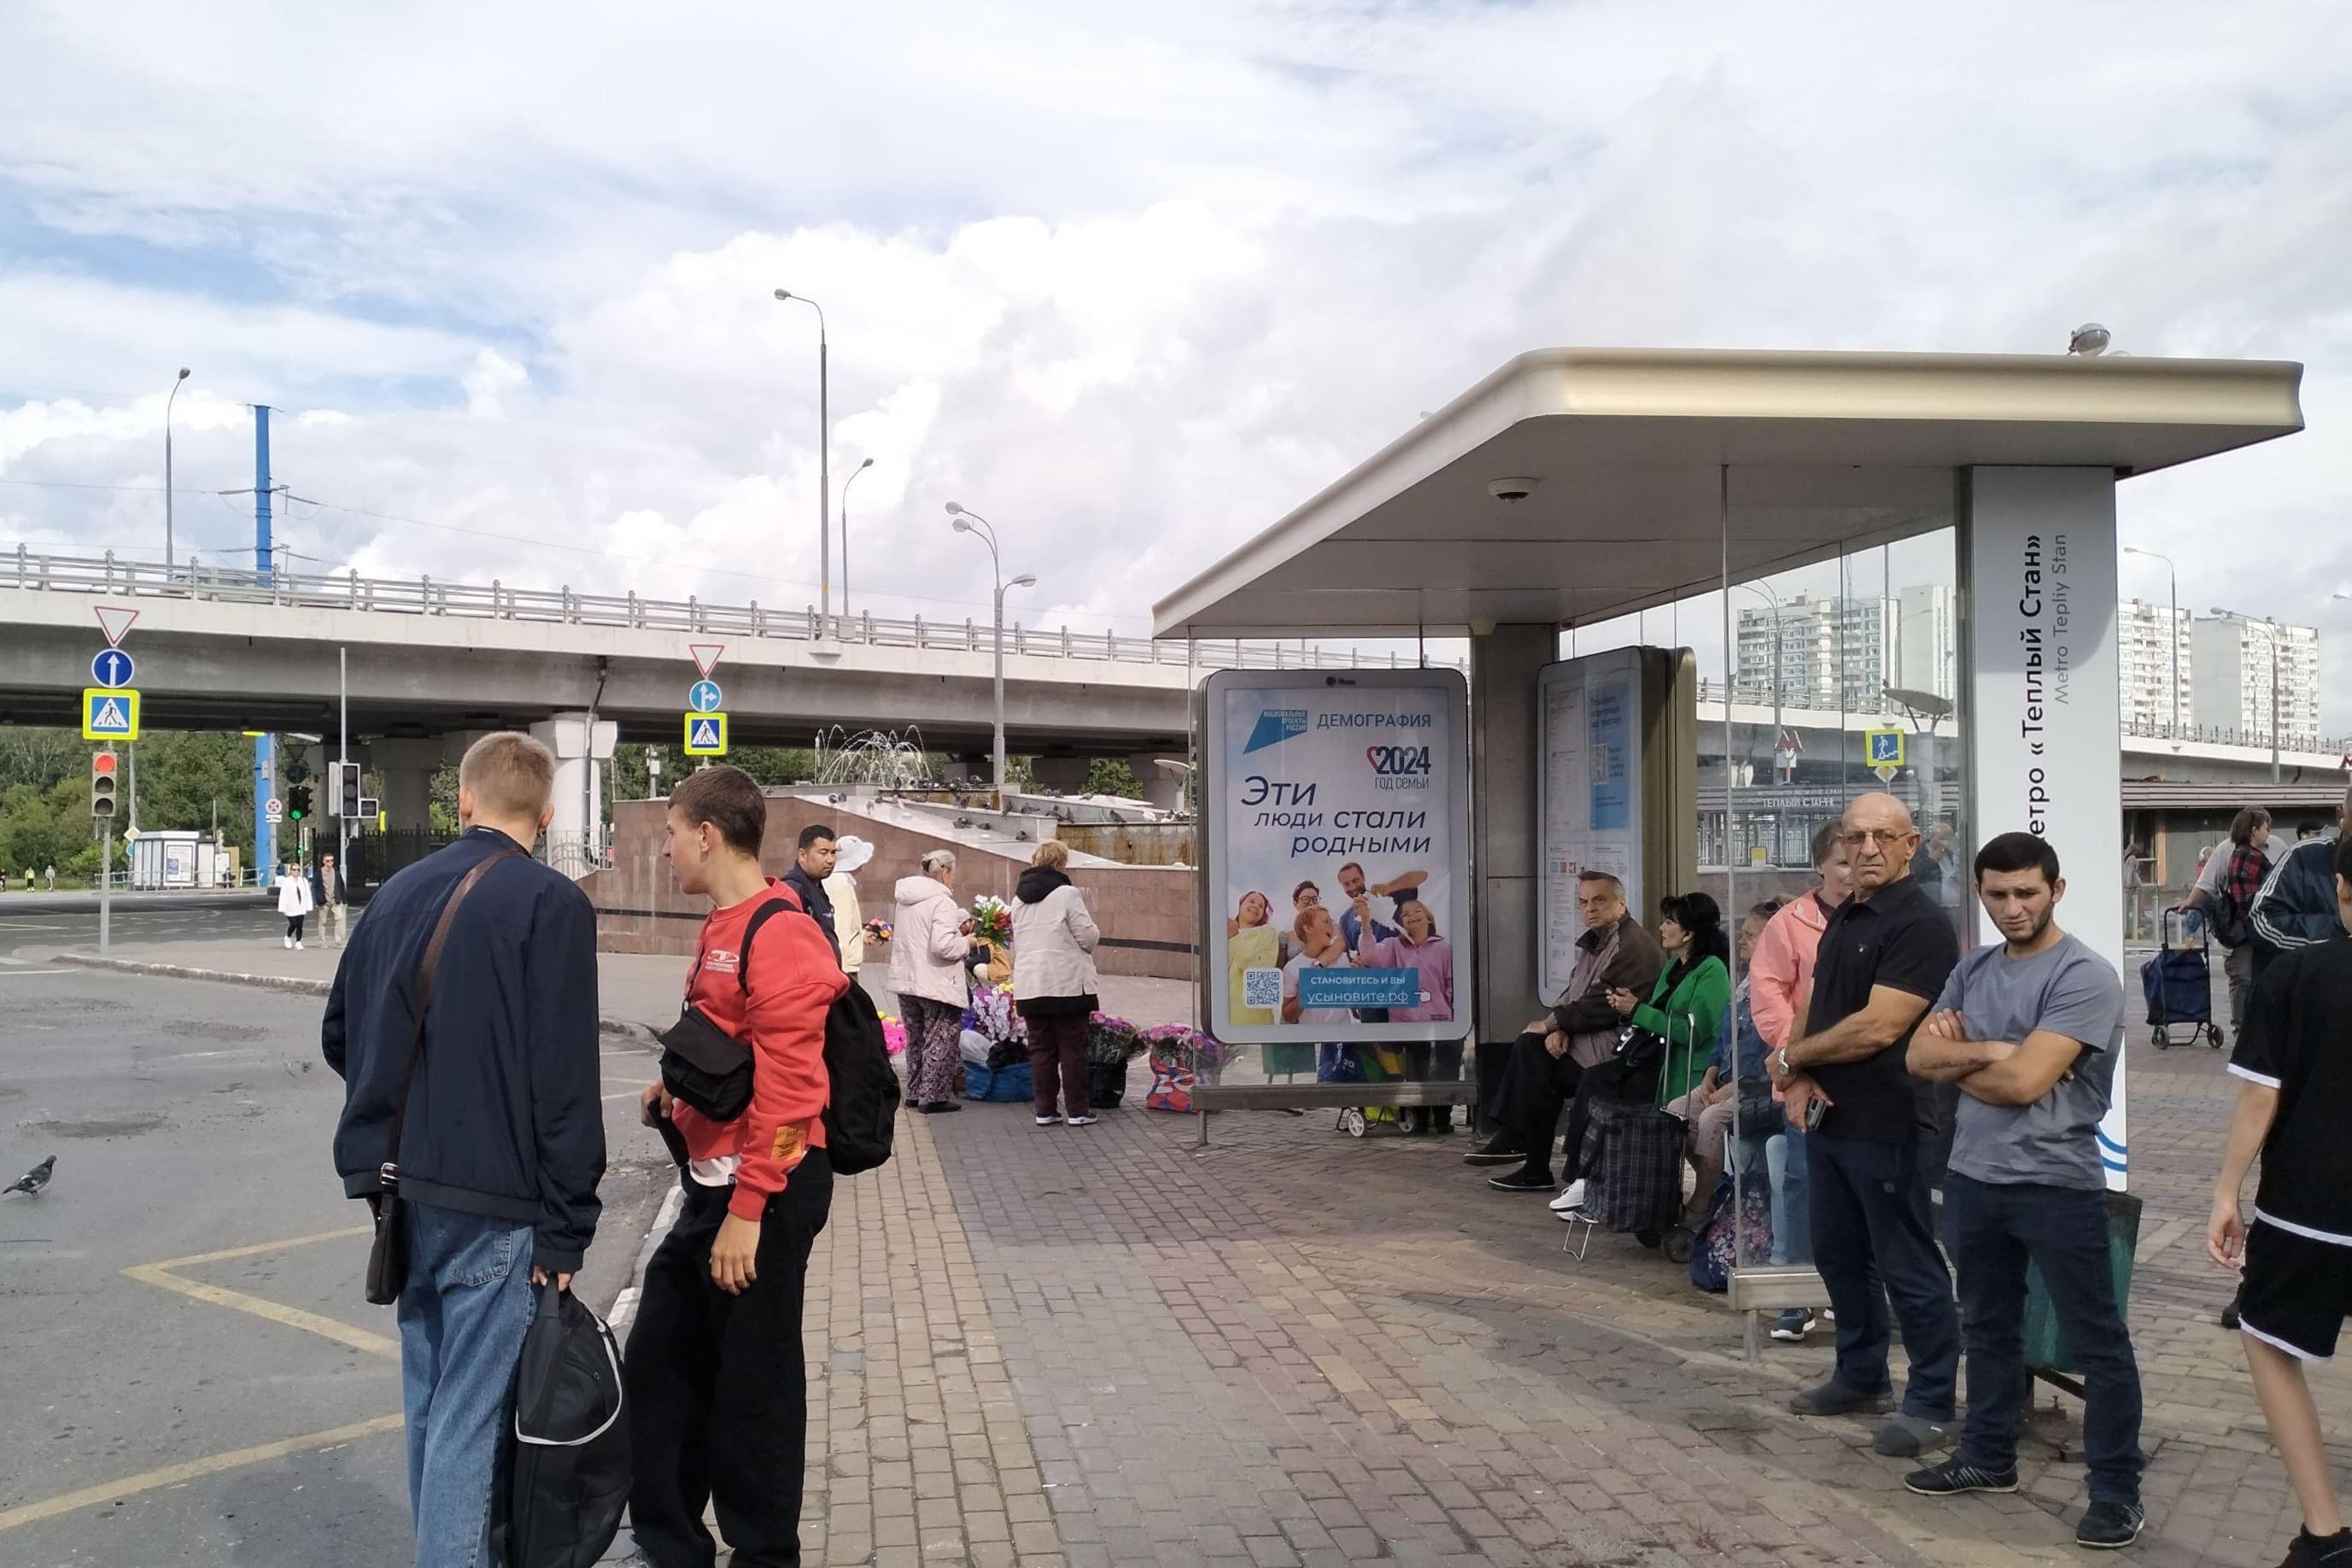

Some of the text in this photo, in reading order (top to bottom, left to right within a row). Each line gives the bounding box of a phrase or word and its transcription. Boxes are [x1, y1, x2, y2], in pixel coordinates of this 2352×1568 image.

[2052, 535, 2071, 705] Metro Tepliy Stan
[1316, 713, 1431, 729] ДЕМОГРАФИЯ
[1375, 746, 1431, 775] 2024
[1241, 775, 1316, 806] Эти
[1375, 777, 1394, 792] ГОД
[2027, 766, 2049, 844] етро
[1254, 810, 1425, 829] люди стали
[1291, 835, 1431, 858] родными
[1310, 976, 1379, 985] СТАНОВИТЕСЬ
[1390, 976, 1406, 985] ВЫ
[1307, 990, 1408, 1004] усыновите.рф
